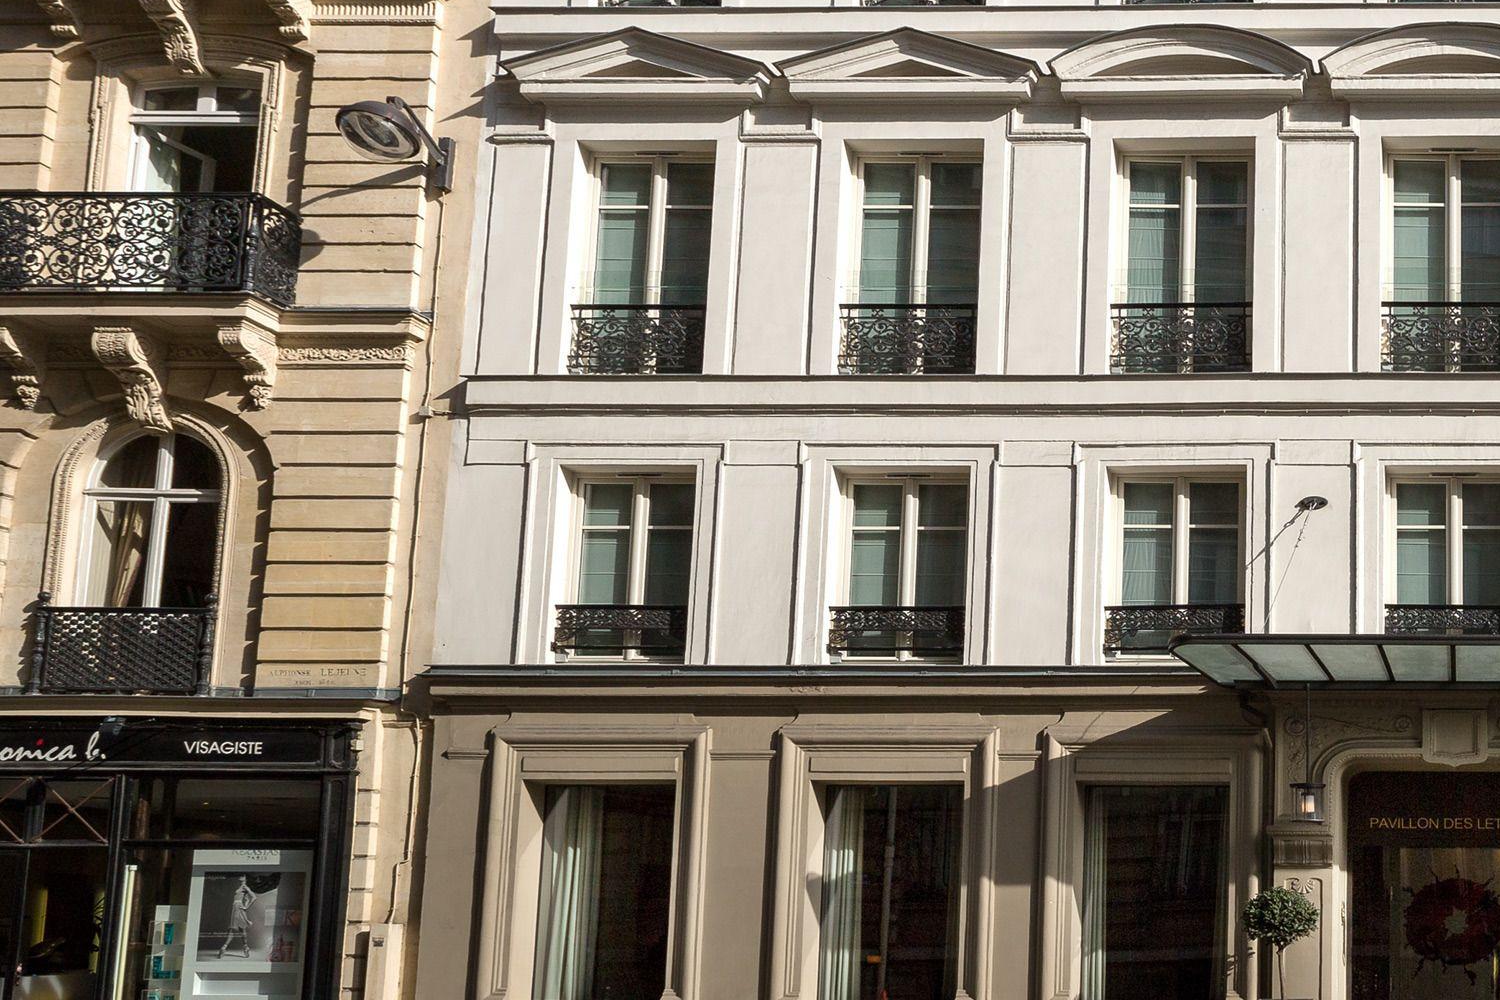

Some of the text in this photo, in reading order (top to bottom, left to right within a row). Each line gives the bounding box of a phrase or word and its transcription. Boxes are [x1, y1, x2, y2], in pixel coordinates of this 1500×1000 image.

[183, 740, 263, 755] VISAGISTE
[1369, 817, 1439, 830] PAVILLON
[1443, 817, 1473, 830] DES
